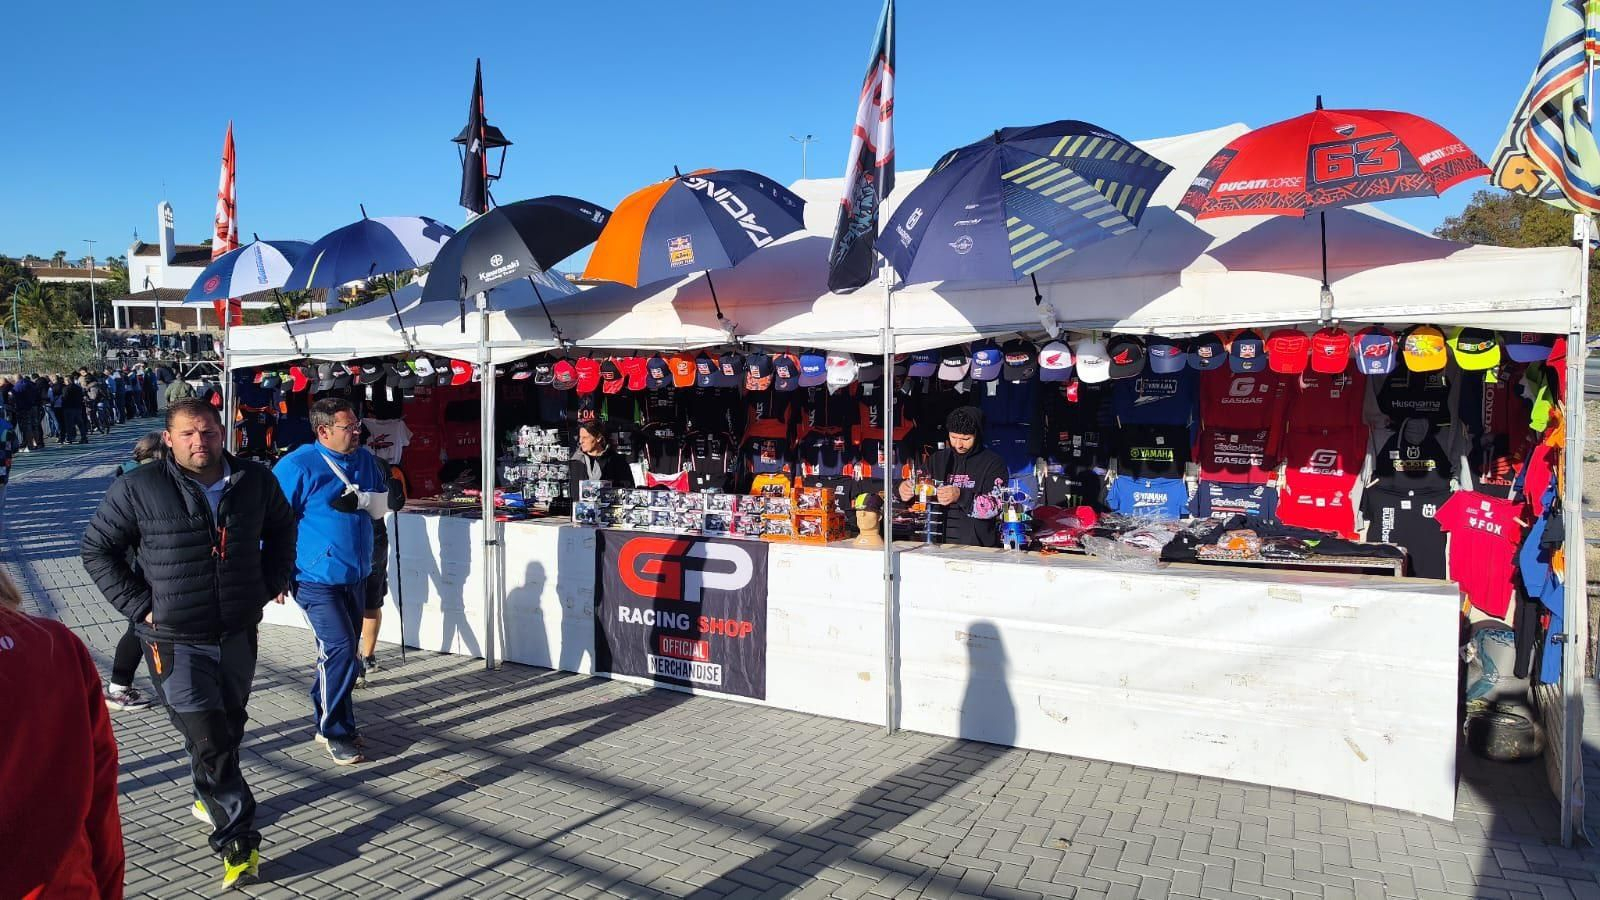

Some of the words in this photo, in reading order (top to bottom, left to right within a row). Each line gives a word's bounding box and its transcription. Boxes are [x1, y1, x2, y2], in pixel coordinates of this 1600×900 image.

[1312, 136, 1401, 184] 63
[479, 259, 519, 280] Kawasaki
[1391, 399, 1441, 408] Husqvarna
[577, 409, 595, 419] FOX
[1140, 449, 1174, 459] YAMAHA
[1214, 456, 1263, 466] GASGAS
[1299, 466, 1344, 477] GASGAS
[1140, 492, 1168, 502] YAMAHA
[1478, 519, 1502, 535] FOX
[618, 537, 753, 602] GP
[618, 606, 690, 630] RACING
[697, 616, 753, 638] SHOP
[662, 638, 706, 659] OFFICIAL
[651, 657, 720, 681] MERCHANDISE
